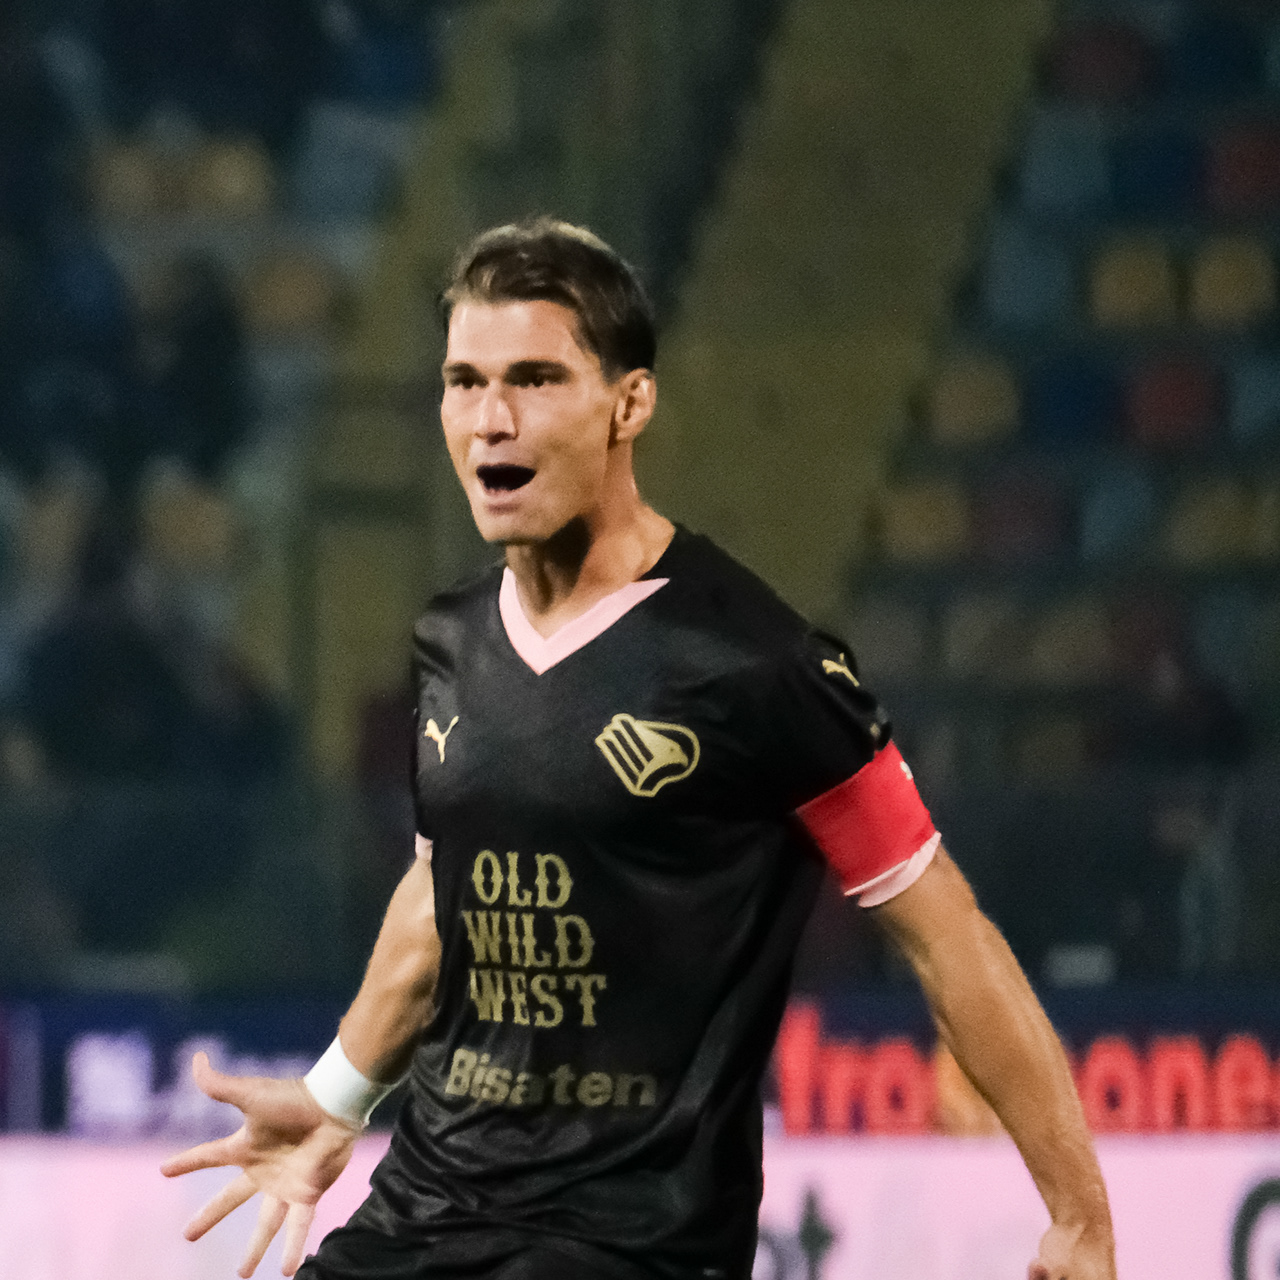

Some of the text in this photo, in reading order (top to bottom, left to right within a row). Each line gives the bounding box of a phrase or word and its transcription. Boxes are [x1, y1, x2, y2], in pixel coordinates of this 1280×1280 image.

[471, 850, 573, 908] OLD
[461, 909, 595, 970] WILD
[469, 969, 606, 1028] WEST
[445, 1047, 658, 1107] Bisaten
